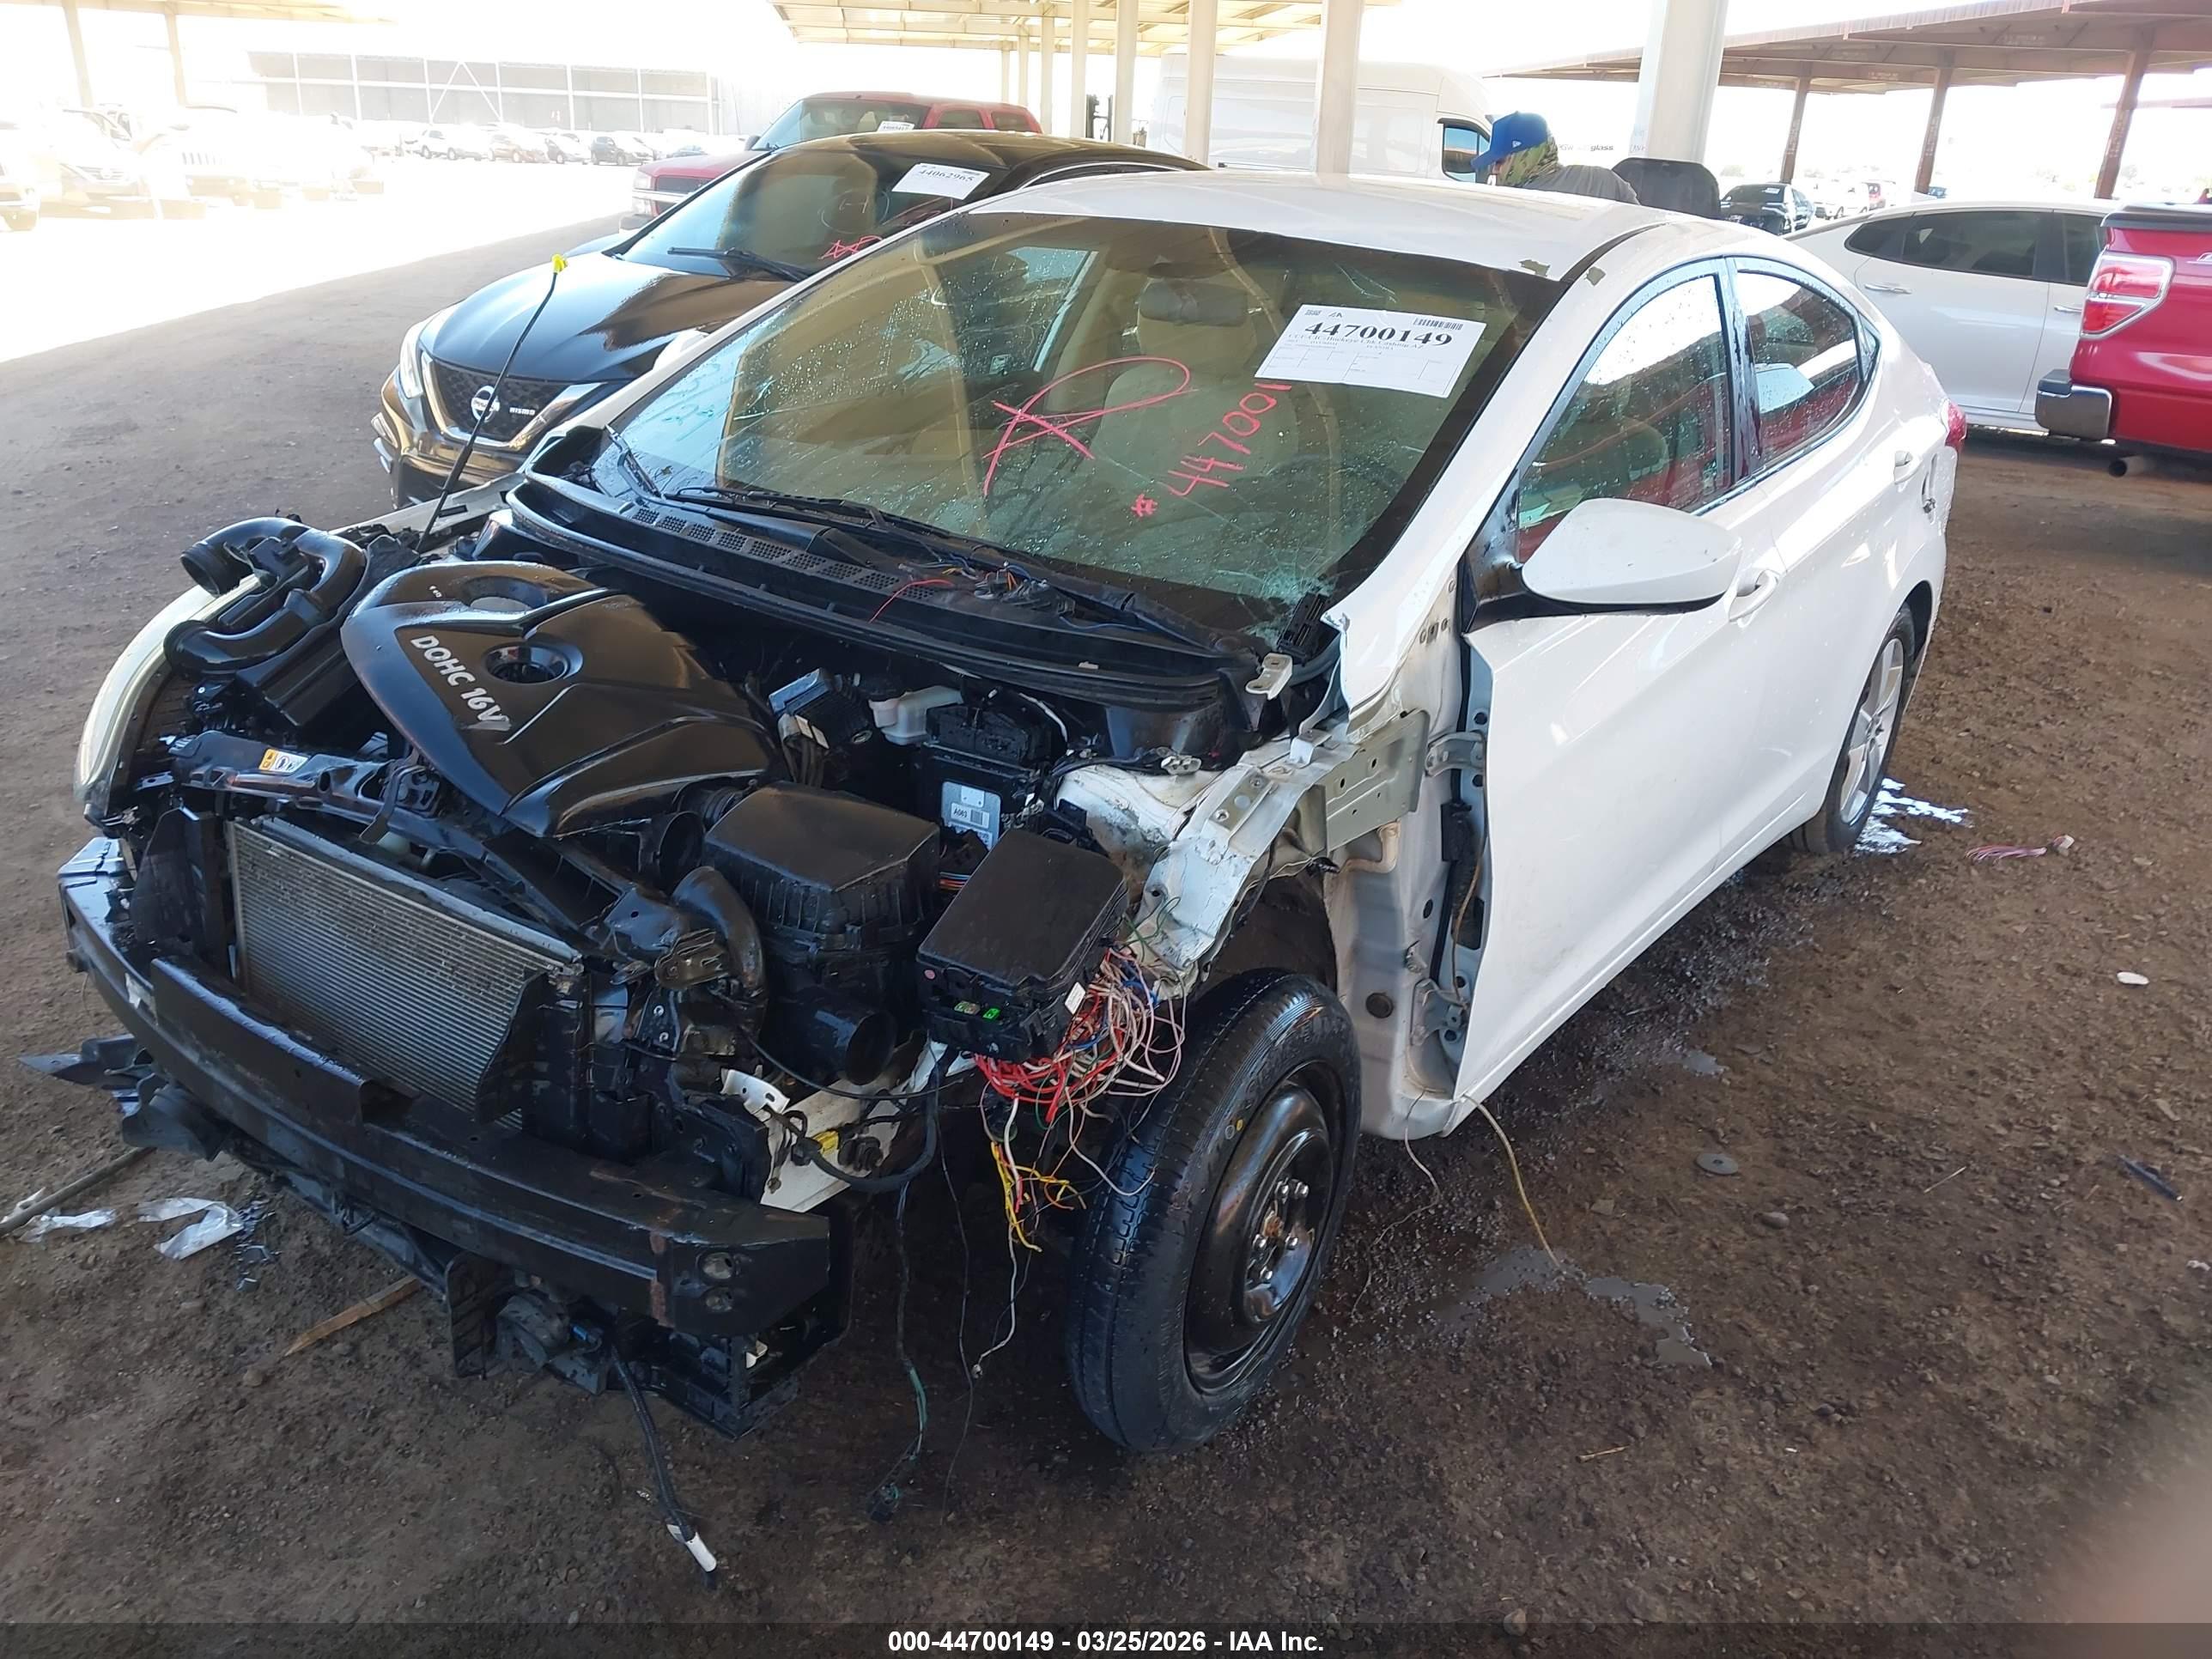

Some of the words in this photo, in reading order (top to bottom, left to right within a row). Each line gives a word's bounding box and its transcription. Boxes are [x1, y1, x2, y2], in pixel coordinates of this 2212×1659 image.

[1305, 322, 1452, 347] 44700149
[410, 635, 476, 686] DOHC
[460, 688, 509, 722] 16V
